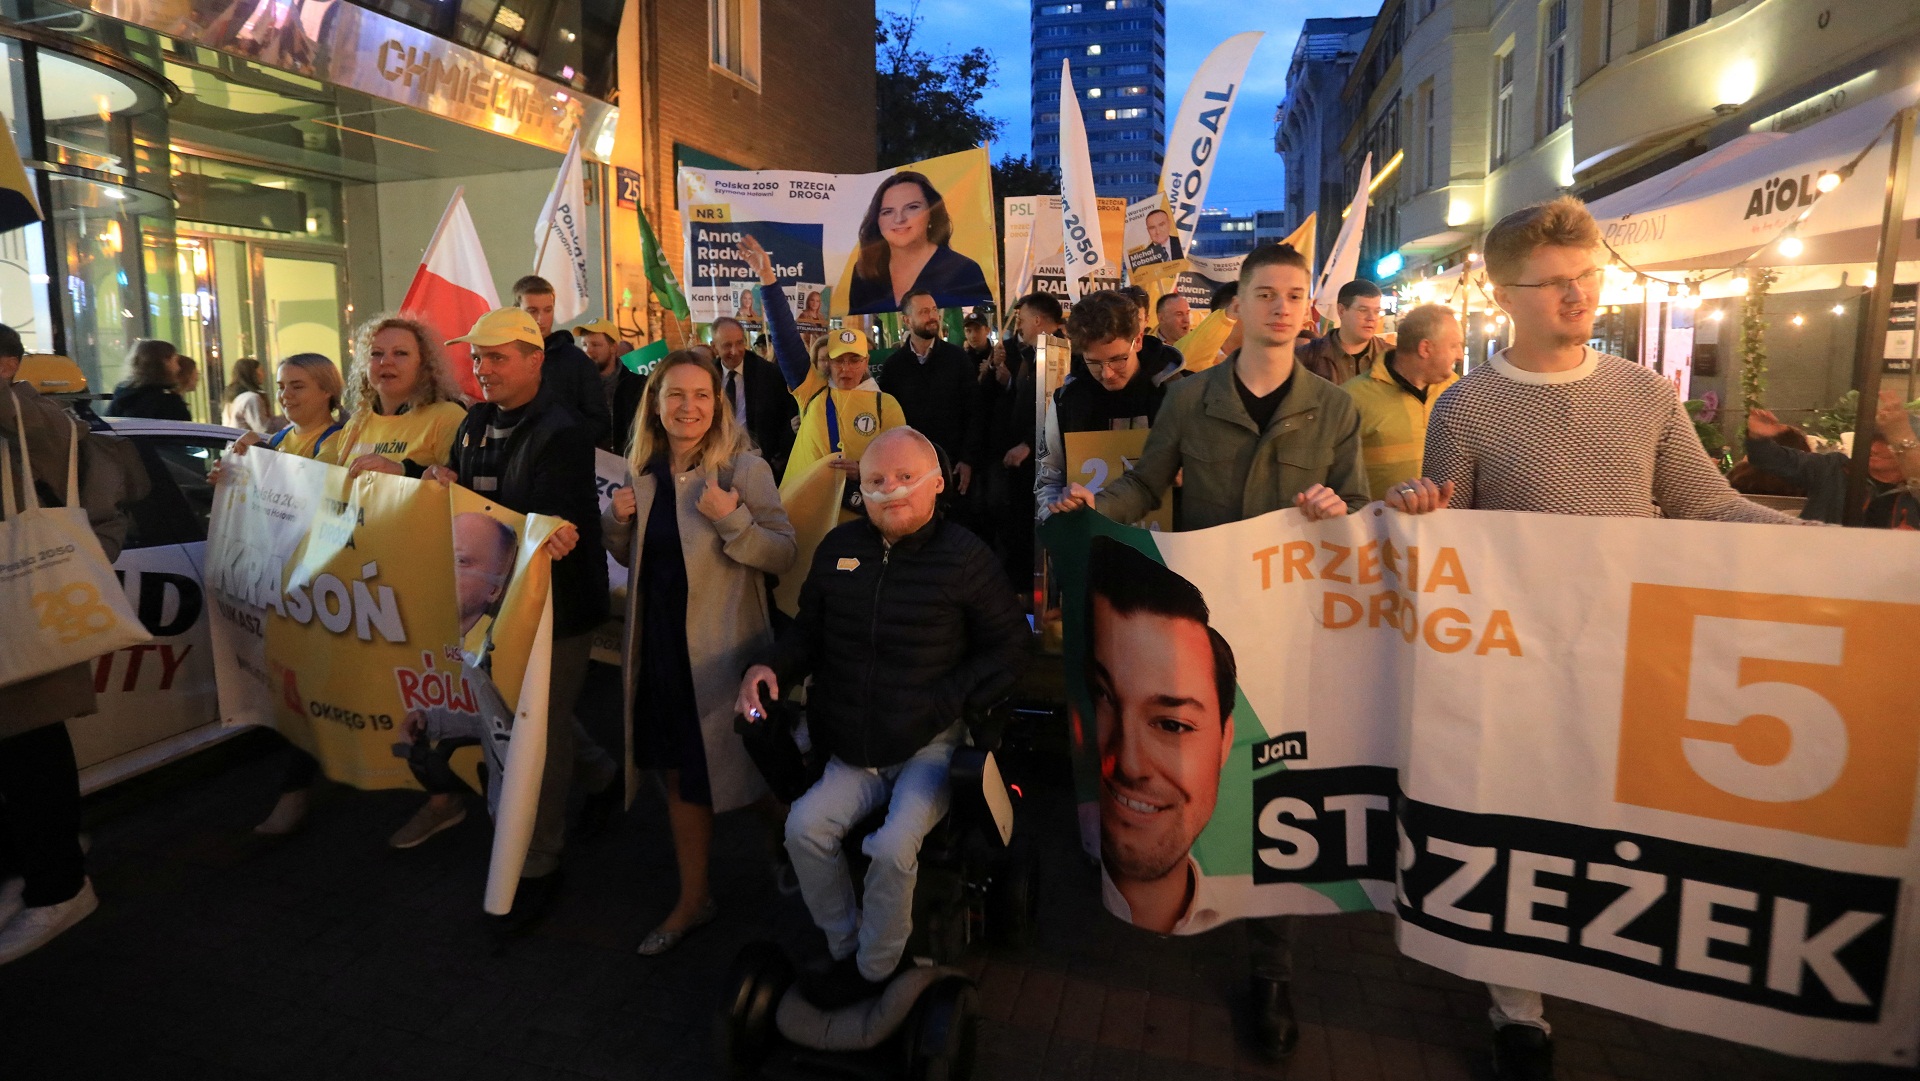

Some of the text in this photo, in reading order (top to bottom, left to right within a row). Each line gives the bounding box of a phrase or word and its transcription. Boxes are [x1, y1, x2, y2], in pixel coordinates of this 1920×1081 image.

[377, 39, 545, 128] CHMIELNA
[1176, 83, 1235, 233] NOGAL
[623, 177, 639, 200] 25
[714, 180, 779, 190] Polska 2050
[789, 180, 836, 192] TRZECIA
[1170, 171, 1183, 214] aweł
[789, 190, 830, 200] DROGA
[696, 208, 724, 219] NR 3
[1009, 203, 1035, 216] PSL
[697, 228, 743, 243] Anna
[1604, 214, 1667, 248] PERONI
[1064, 214, 1099, 266] 2050
[1129, 248, 1155, 262] Michał
[698, 262, 804, 278] Röhrenchef
[1038, 266, 1065, 275] ANNA
[1099, 268, 1106, 276] 3
[844, 332, 851, 342] 7
[861, 417, 870, 432] 7
[373, 438, 408, 454] WAŻNI
[212, 541, 407, 643] KRASOŃ
[1322, 590, 1524, 657] DROGA
[310, 700, 394, 731] OKRĘG 19
[1680, 614, 1849, 803] 5
[1257, 738, 1302, 764] Jan
